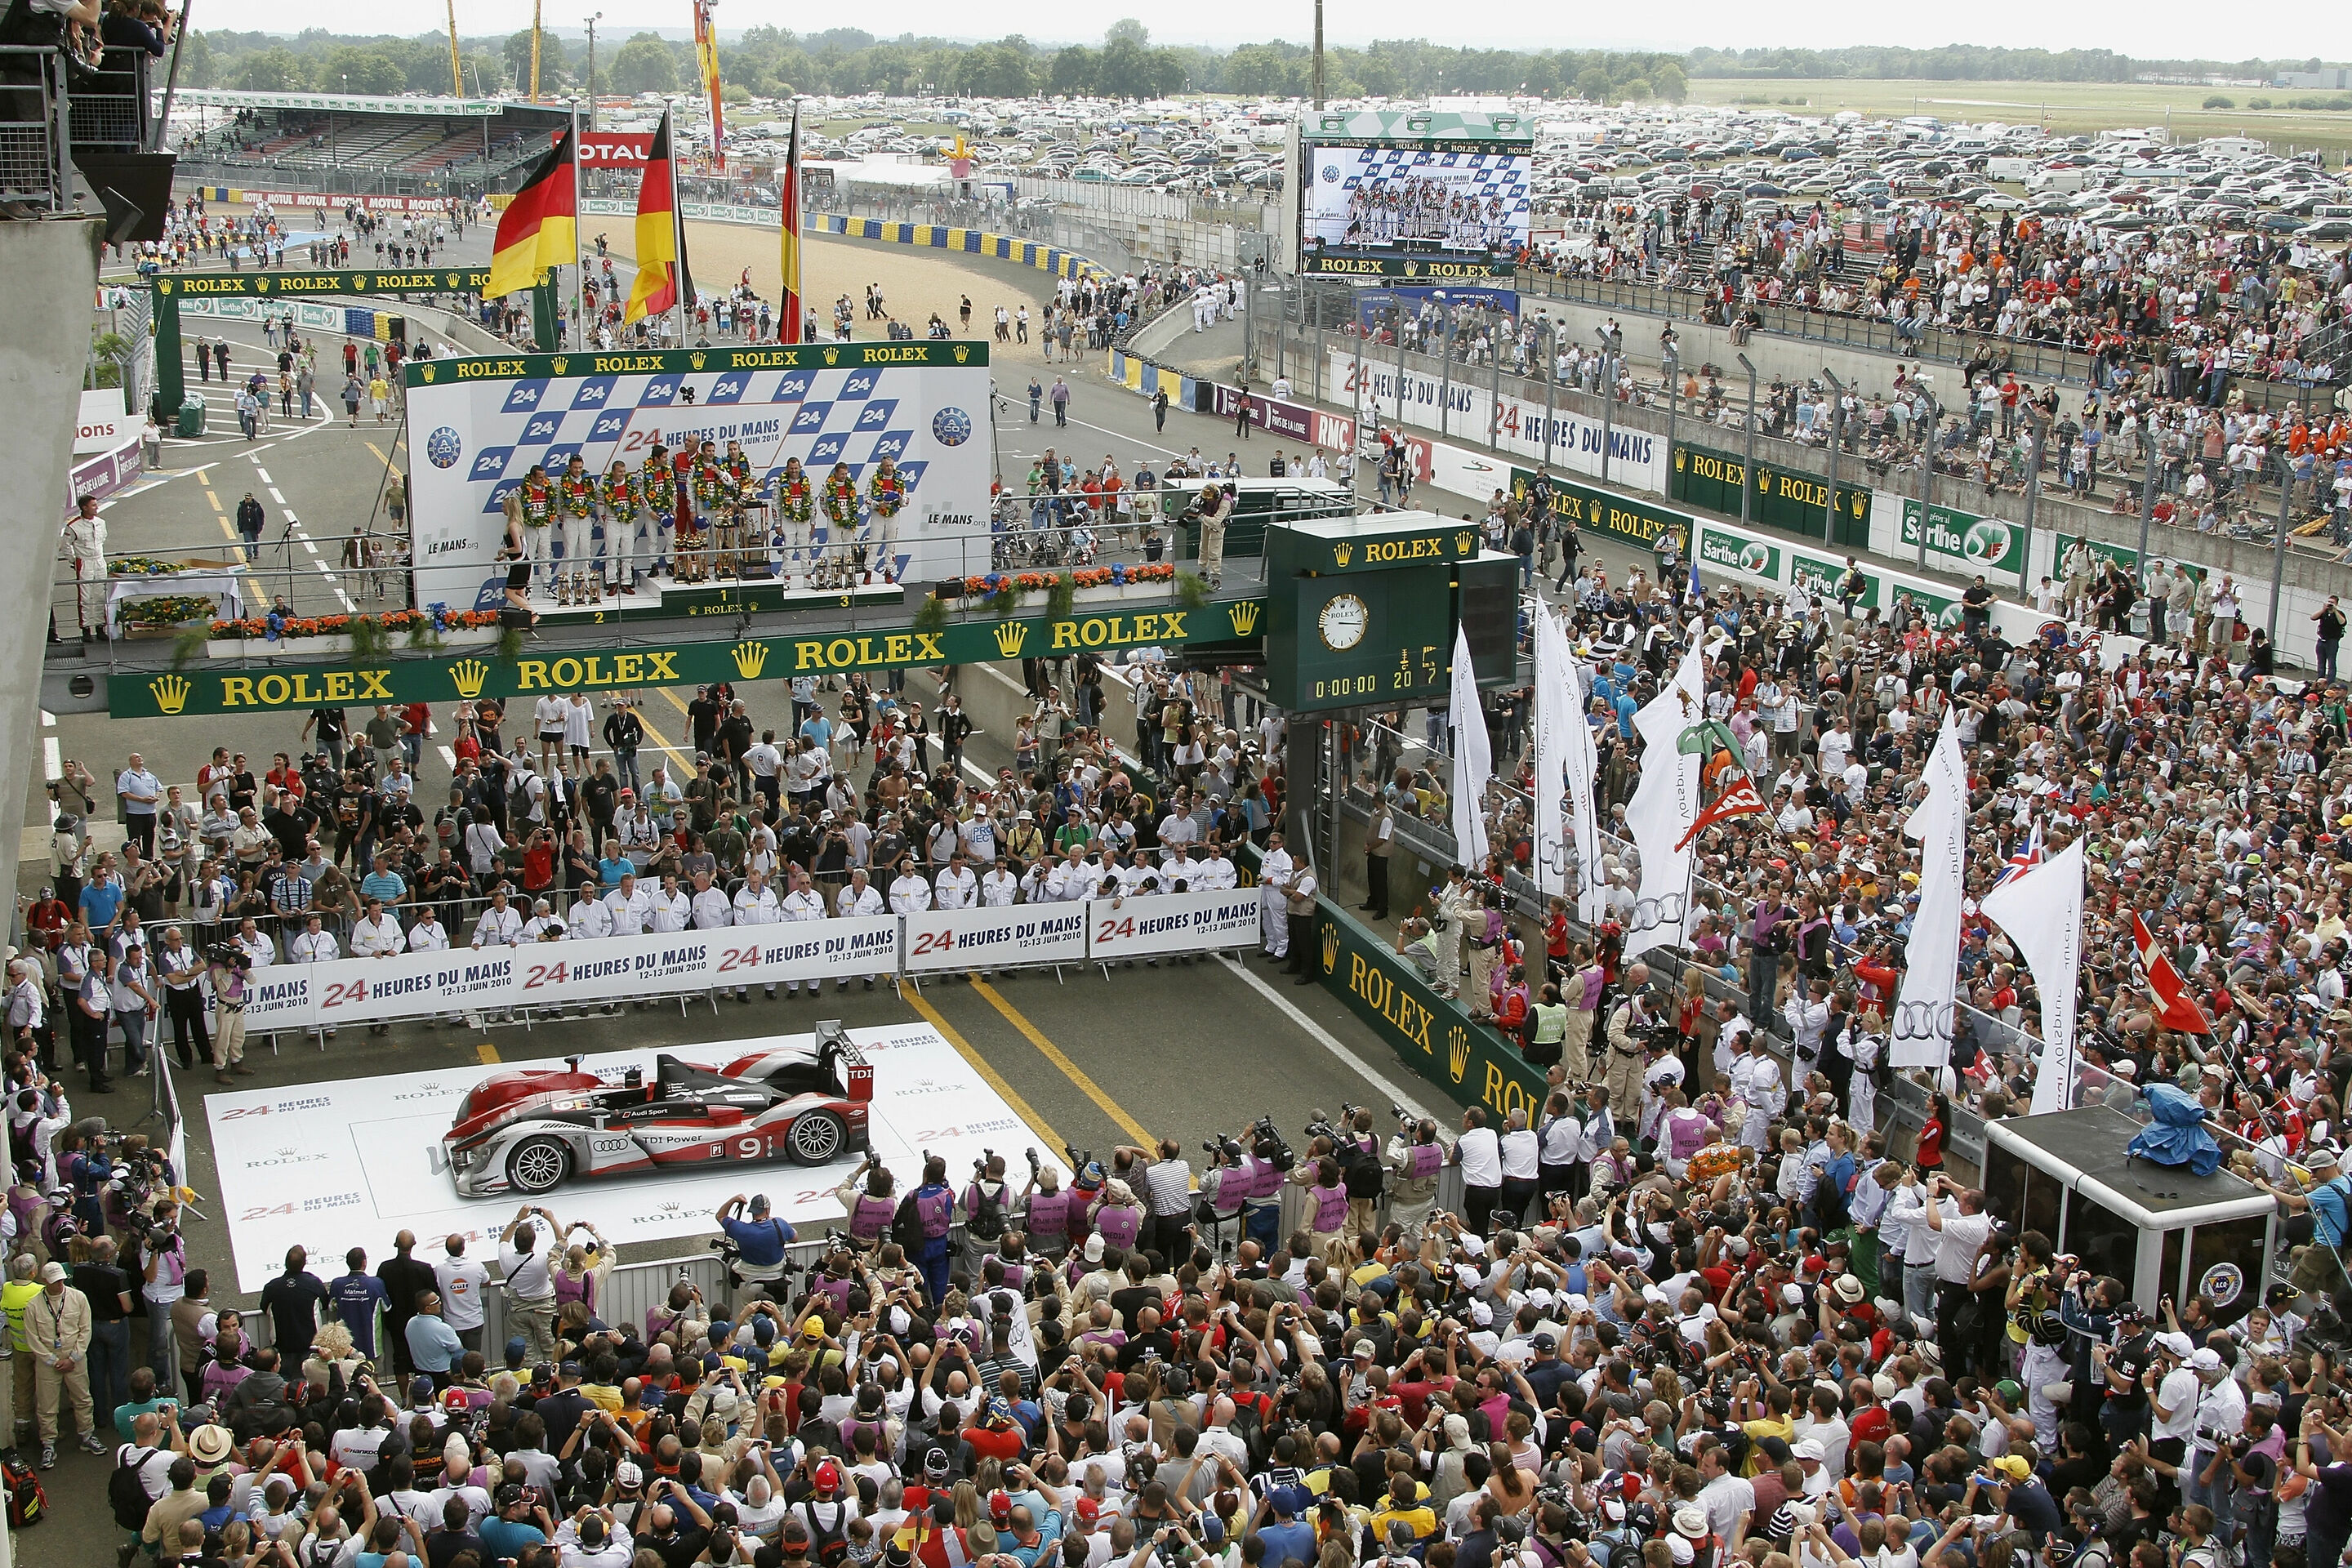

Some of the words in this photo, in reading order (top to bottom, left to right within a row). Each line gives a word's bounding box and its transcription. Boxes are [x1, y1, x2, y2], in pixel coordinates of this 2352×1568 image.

[556, 140, 650, 160] OTAL
[1451, 145, 1479, 153] ROLEX
[1505, 173, 1516, 181] 24
[267, 194, 293, 205] MOTUL
[297, 195, 327, 207] MOTUL
[368, 198, 403, 210] MOTUL
[1321, 258, 1383, 274] ROLEX
[1428, 263, 1491, 278] ROLEX
[182, 278, 245, 292] ROLEX
[280, 277, 341, 291] ROLEX
[376, 274, 436, 288] ROLEX
[220, 302, 242, 312] Sarthe
[304, 310, 321, 320] Sarthe
[457, 361, 527, 378] ROLEX
[595, 356, 664, 372] ROLEX
[732, 351, 799, 368] ROLEX
[863, 347, 928, 363] ROLEX
[715, 381, 738, 397] 24
[849, 377, 871, 392] 24
[511, 388, 537, 405] 24
[1418, 381, 1434, 405] DU
[862, 409, 885, 423] 24
[597, 417, 622, 434] 24
[1317, 415, 1349, 452] RMC
[1488, 402, 1521, 439] 24
[1581, 426, 1602, 454] DU
[1609, 431, 1653, 464] MANS
[623, 428, 663, 452] 24
[719, 424, 738, 439] DU
[742, 419, 780, 437] MANS
[744, 437, 760, 445] JUIN
[763, 434, 779, 443] 2010
[878, 439, 902, 454] 24
[548, 452, 571, 468] 24
[1693, 455, 1745, 486] ROLEX
[928, 514, 939, 525] LE
[939, 515, 987, 528] MANS.org
[1547, 494, 1582, 519] LEX
[1609, 509, 1664, 541] ROLEX
[1907, 505, 1922, 515] Cons
[1929, 513, 1950, 524] général
[428, 543, 438, 555] LE
[439, 538, 479, 553] MANS.org
[1365, 537, 1442, 562] ROLEX
[1704, 540, 1738, 565] Sarthe
[1795, 560, 1810, 569] Conseil
[1810, 564, 1826, 575] général
[1795, 568, 1833, 595] Srthe
[480, 587, 505, 603] 24
[720, 590, 727, 601] 1
[840, 595, 849, 608] 3
[1913, 596, 1931, 606] général
[704, 604, 743, 615] ROLEX
[1331, 611, 1354, 619] ROLEX
[595, 612, 604, 624] 2
[220, 670, 394, 706] ROLEX
[517, 651, 679, 690] ROLEX
[795, 634, 945, 670] ROLEX
[1052, 612, 1187, 648] ROLEX
[1316, 675, 1375, 698] 0:00:00
[1394, 670, 1411, 688] 20
[1429, 668, 1436, 684] 7
[972, 834, 994, 843] JECT
[269, 872, 287, 881] NEVAD
[1094, 915, 1136, 944] 24
[1138, 913, 1189, 936] HEURES
[1193, 909, 1212, 926] DU
[1217, 902, 1257, 921] MANS
[1196, 924, 1218, 934] 12-13
[1218, 920, 1236, 931] JUIN
[1238, 917, 1256, 927] 2010
[911, 929, 956, 956] 24
[958, 926, 1011, 949] HEURES
[1015, 923, 1036, 939] DU
[1040, 915, 1082, 935] MANS
[1019, 938, 1041, 948] 12-13
[1042, 934, 1060, 944] JUIN
[1062, 931, 1081, 941] 2010
[717, 944, 761, 973] 24
[765, 941, 820, 964] HEURES
[825, 937, 845, 954] DU
[850, 929, 893, 950] MANS
[829, 953, 851, 963] 12-13
[853, 949, 871, 959] JUIN
[874, 946, 893, 955] 2010
[523, 960, 570, 990] 24
[573, 957, 630, 980] HEURES
[635, 953, 657, 970] DU
[662, 944, 706, 966] MANS
[639, 969, 662, 980] 12-13
[665, 965, 684, 975] JUIN
[686, 961, 707, 972] 2010
[260, 980, 307, 1002] MANS
[321, 978, 368, 1009] 24
[373, 974, 431, 1000] HEURES
[438, 969, 459, 987] DU
[466, 960, 511, 982] MANS
[442, 985, 467, 996] 12-13
[469, 981, 488, 992] JUIN
[490, 977, 511, 988] 2010
[264, 1000, 284, 1013] JUIN
[287, 997, 308, 1008] 2010
[1349, 951, 1434, 1055] ROLEX
[890, 1035, 935, 1045] HEURES
[849, 1070, 872, 1079] TDI
[394, 1086, 470, 1101] ROLEX
[893, 1084, 967, 1096] ROLEX
[217, 1104, 274, 1122] 24
[278, 1097, 332, 1109] HEURES
[297, 1102, 332, 1111] MANS
[630, 1109, 647, 1117] Audi
[648, 1108, 668, 1117] Sport
[915, 1127, 965, 1143] 24
[965, 1117, 1014, 1130] HEURES
[666, 1134, 702, 1143] Power
[712, 1145, 722, 1156] P1
[738, 1138, 761, 1159] 9
[245, 1153, 331, 1168] ROLEX
[238, 1201, 299, 1222] 24
[304, 1192, 360, 1206] HEURES
[304, 1204, 323, 1212] DU
[327, 1198, 361, 1209] MANS
[631, 1208, 715, 1224] ROLEX
[1104, 1231, 1125, 1240] MEDIA
